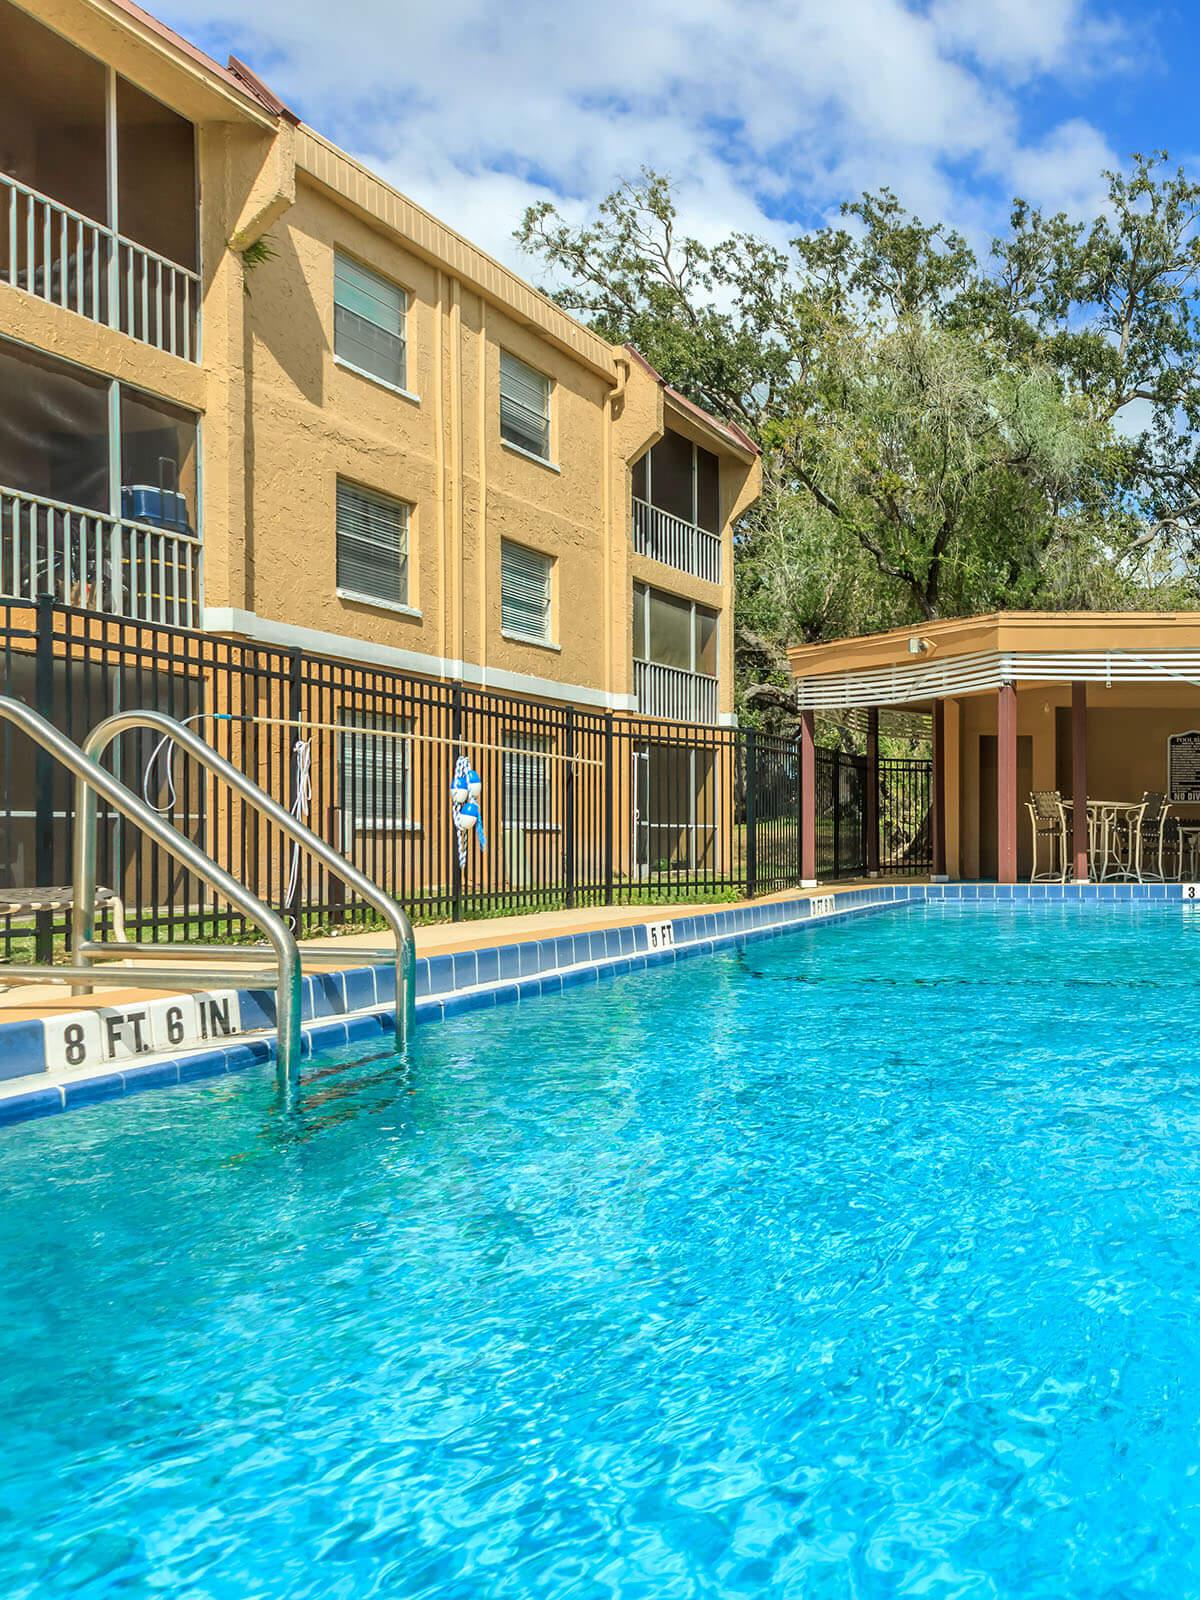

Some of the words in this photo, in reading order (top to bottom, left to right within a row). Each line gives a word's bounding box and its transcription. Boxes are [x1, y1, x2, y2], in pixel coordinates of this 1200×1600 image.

[1173, 792, 1185, 800] NO
[1188, 886, 1195, 899] 3
[651, 927, 657, 947] 5
[64, 1023, 87, 1066] 8
[105, 1011, 149, 1058] FT.
[166, 1006, 184, 1045] 6
[199, 998, 237, 1040] IN.
